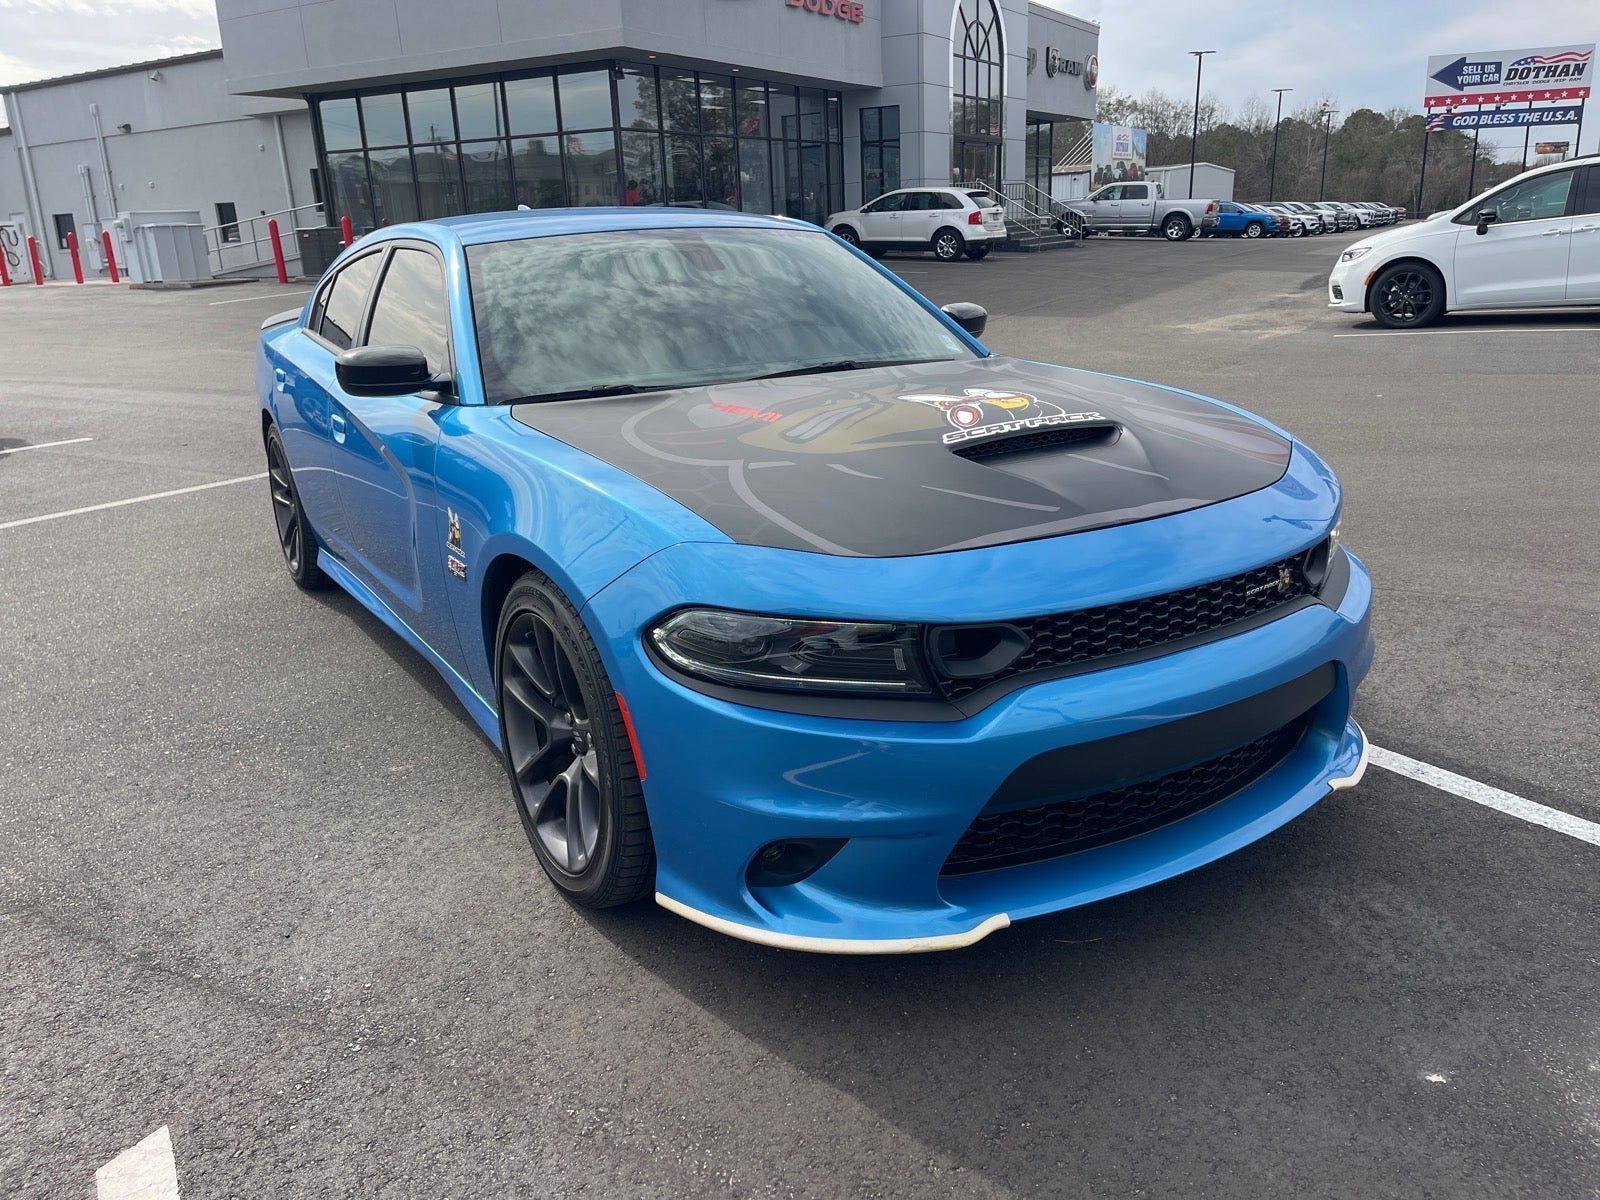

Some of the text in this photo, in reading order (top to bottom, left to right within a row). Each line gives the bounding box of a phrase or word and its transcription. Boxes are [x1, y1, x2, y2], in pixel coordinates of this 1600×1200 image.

[1059, 58, 1083, 76] RAM
[1462, 64, 1496, 74] SELL US
[1504, 63, 1587, 81] DOTHAN
[1457, 73, 1500, 85] YOUR CAR
[1452, 110, 1578, 127] GOD BLESS THE U.S.A.
[708, 401, 783, 424] HEMI
[942, 411, 1107, 444] SCAT PACK
